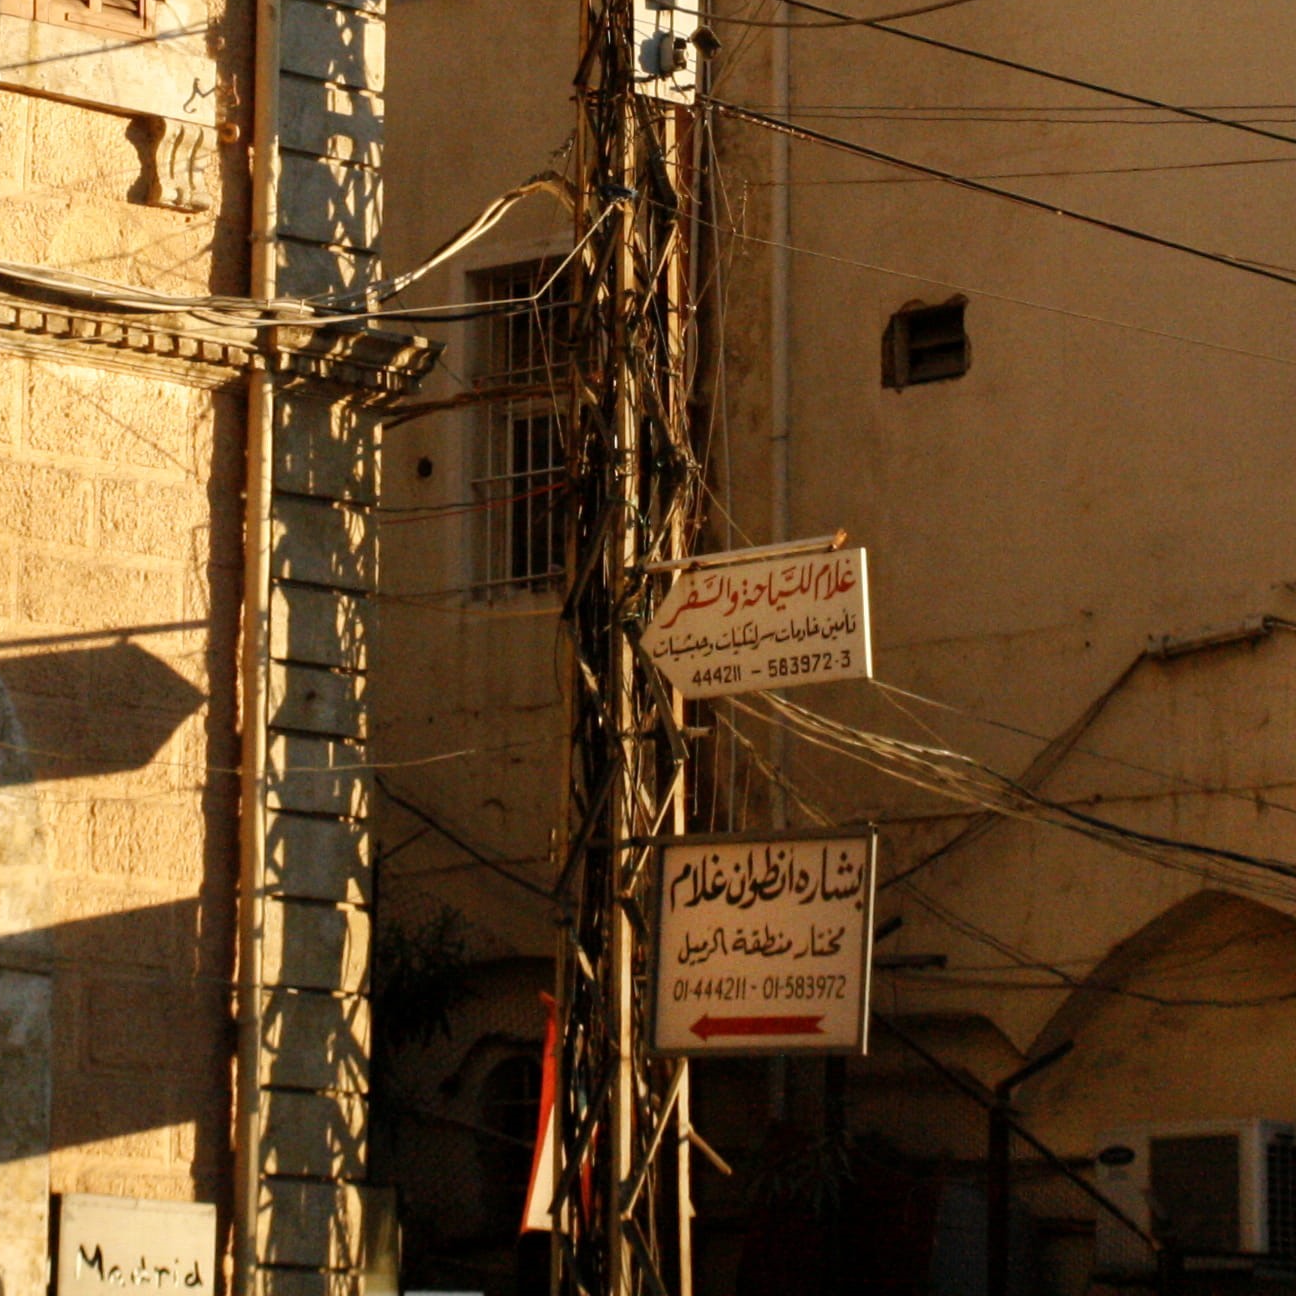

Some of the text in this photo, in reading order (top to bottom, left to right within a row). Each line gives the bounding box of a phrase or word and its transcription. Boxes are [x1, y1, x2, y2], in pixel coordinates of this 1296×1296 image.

[815, 559, 857, 601] غلام
[775, 615, 820, 643] خادمات
[821, 608, 857, 640] تأمين
[652, 632, 713, 661] وحبشيات
[692, 665, 742, 687] 444211
[670, 853, 728, 914] غلام
[678, 922, 846, 966] مختار منطقة الرميل
[673, 977, 747, 1002] 01-444211
[763, 975, 847, 999] 01-583972
[75, 1243, 202, 1288] Madrid
